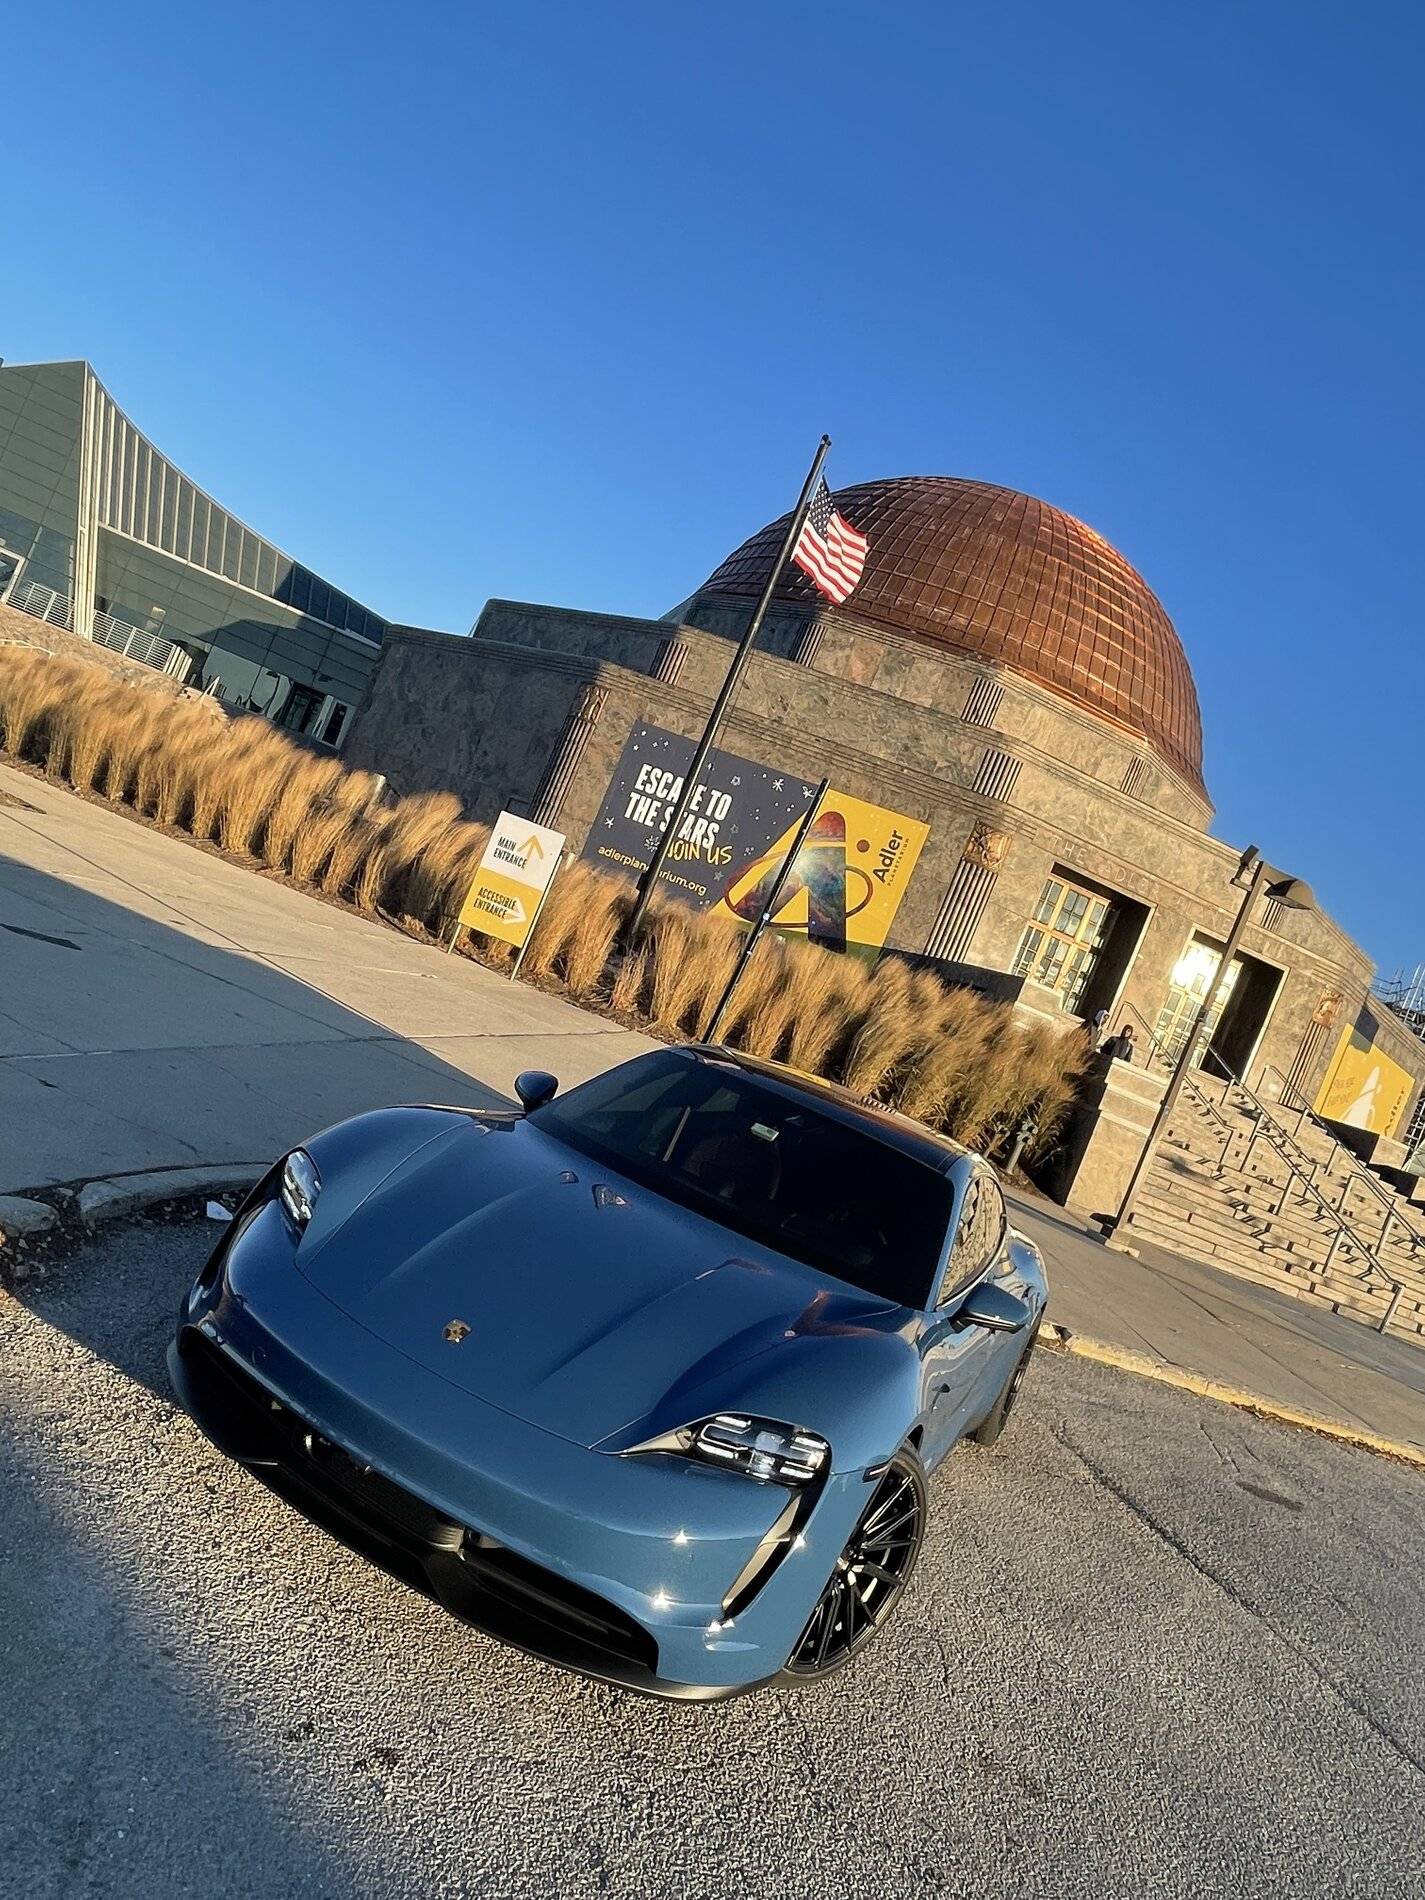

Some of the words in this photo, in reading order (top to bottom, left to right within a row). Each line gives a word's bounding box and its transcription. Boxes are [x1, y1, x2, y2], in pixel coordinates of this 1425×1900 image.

[634, 763, 708, 811] ESCAE
[705, 789, 733, 821] TO
[624, 792, 662, 827] THE
[659, 806, 720, 849] SARS
[497, 836, 517, 850] MAIN
[667, 840, 701, 861] JOIN
[493, 847, 529, 869] ENTRANCE
[873, 829, 903, 883] Adler
[598, 845, 708, 896] adlerplanrium.org
[473, 898, 509, 919] ENTRANCE
[477, 887, 518, 911] ACCESSIBLE
